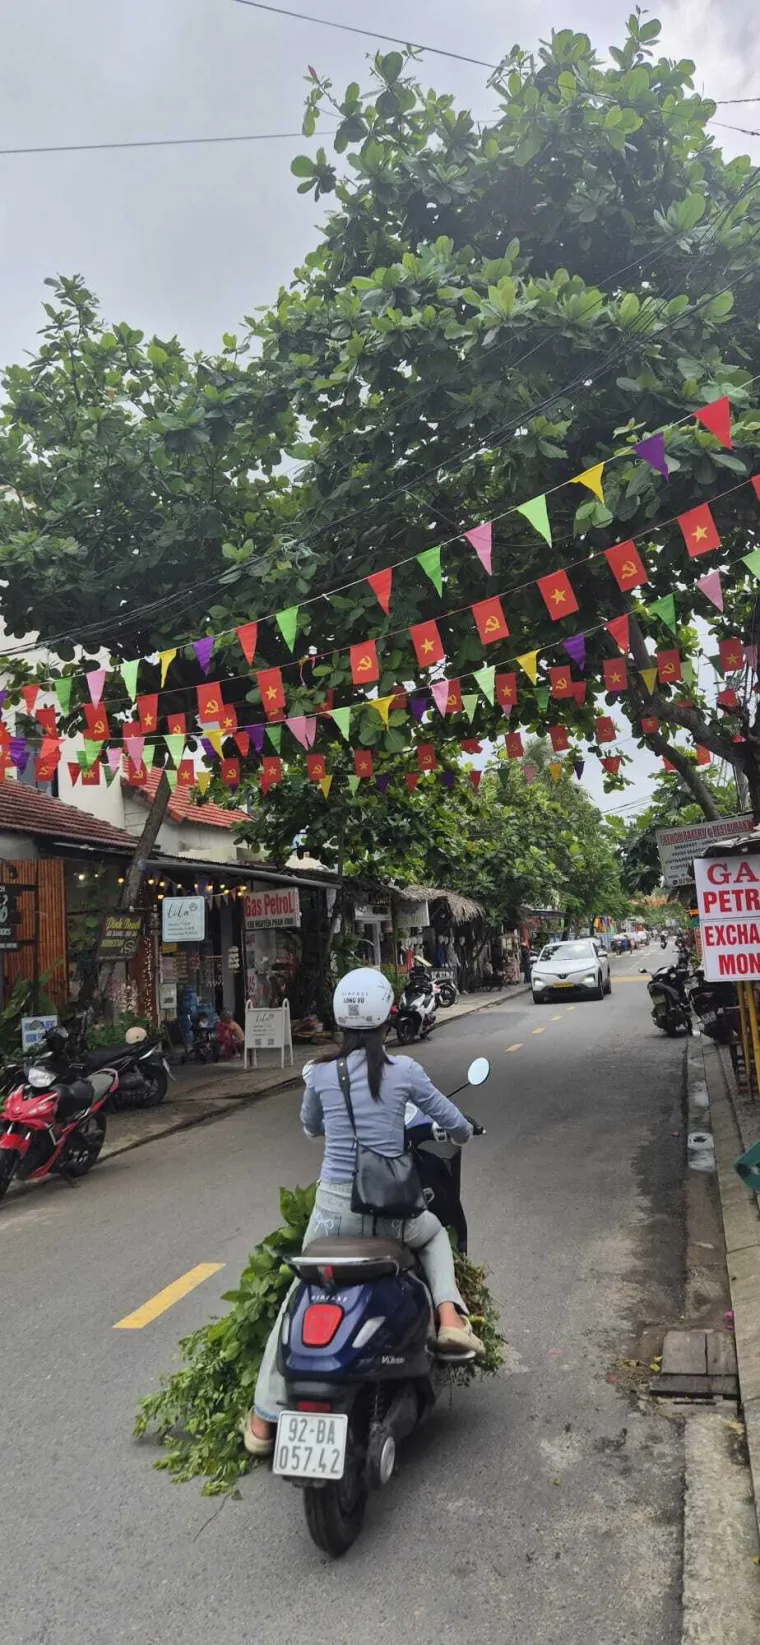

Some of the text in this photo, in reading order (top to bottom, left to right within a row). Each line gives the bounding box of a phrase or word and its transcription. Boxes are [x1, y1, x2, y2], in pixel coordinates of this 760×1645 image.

[707, 861, 760, 886] GA
[246, 896, 262, 917] Gas
[704, 923, 760, 947] EXCHA
[718, 953, 760, 976] MON
[288, 1417, 335, 1444] 92-BA
[279, 1445, 341, 1474] 057.42
